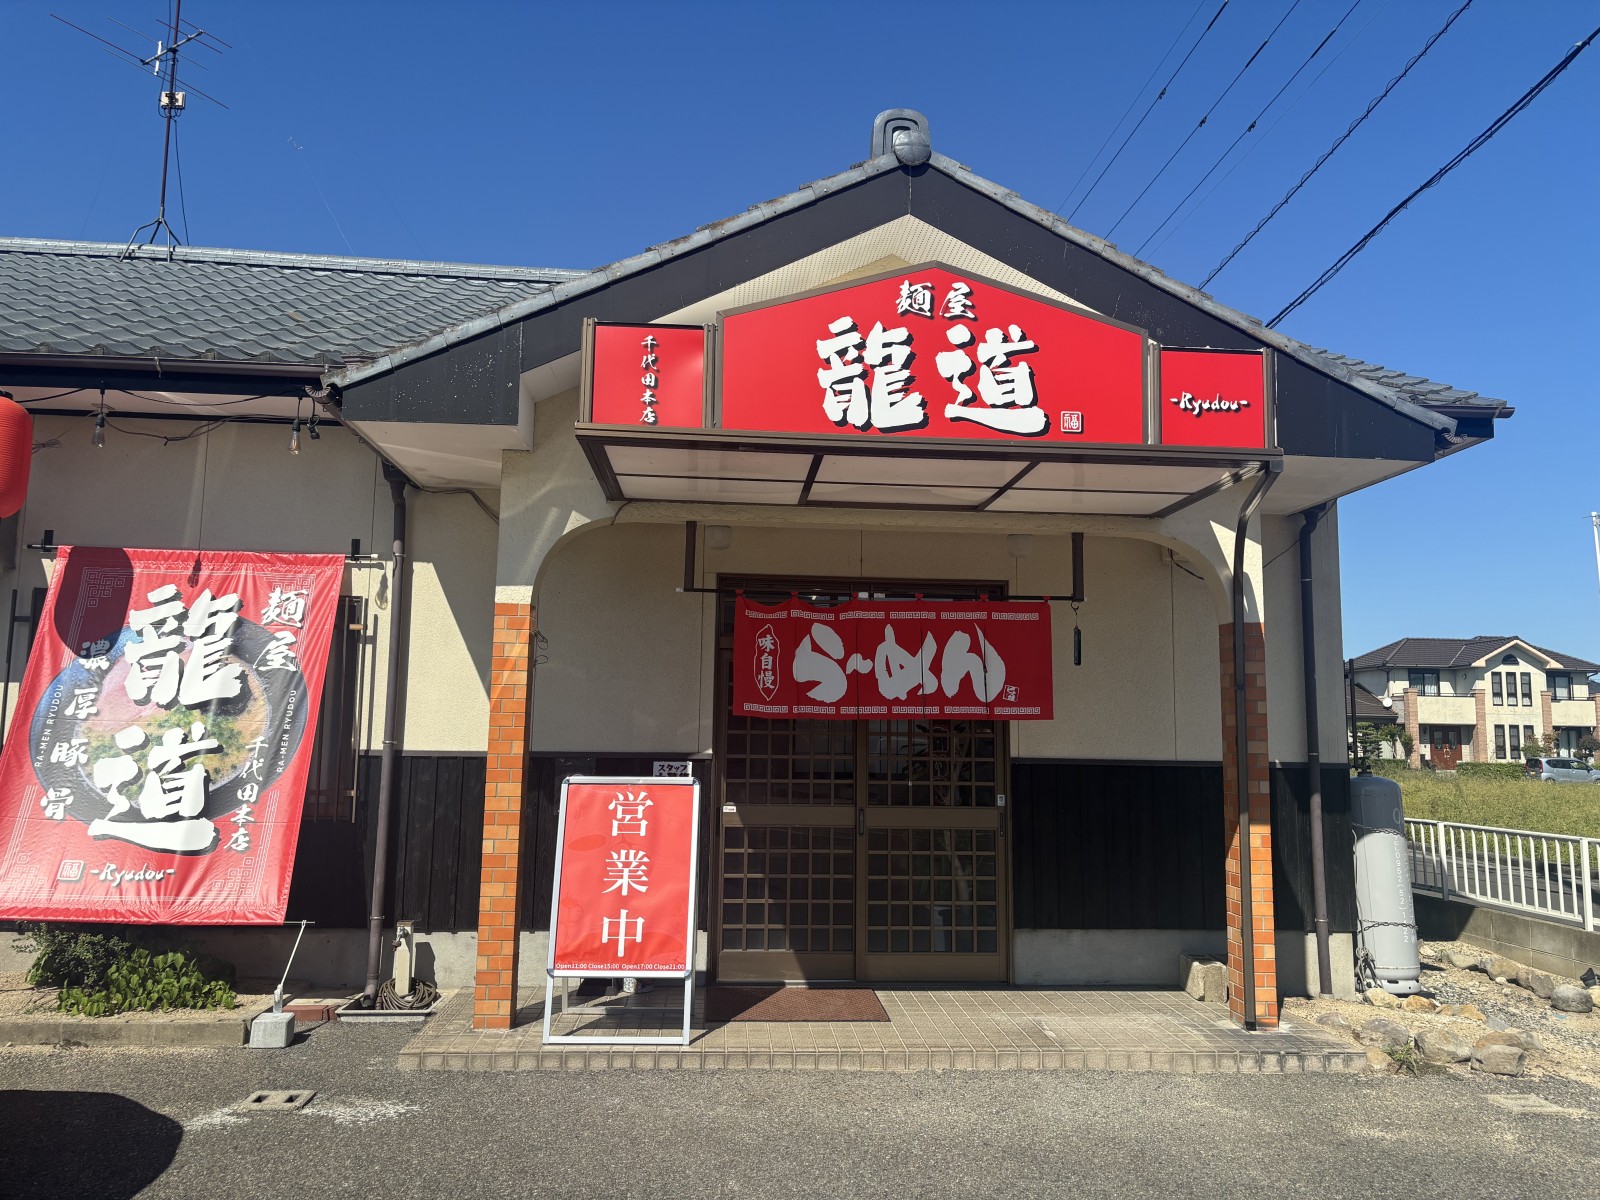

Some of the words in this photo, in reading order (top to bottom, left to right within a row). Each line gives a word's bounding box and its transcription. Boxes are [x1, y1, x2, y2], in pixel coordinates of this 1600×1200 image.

[639, 336, 657, 423] 千代田本店
[816, 316, 1046, 433] 龍道
[758, 634, 775, 689] 味自慢
[793, 622, 1006, 703] らーめん
[34, 728, 52, 768] RA-MEN
[46, 684, 64, 725] RYUDOU
[40, 639, 111, 820] 濃厚豚骨
[88, 584, 243, 850] 龍道
[276, 734, 290, 773] RA-MEN
[283, 690, 297, 730] RYUDOU
[223, 735, 269, 851] 千代田本店
[601, 791, 654, 958] 営業中
